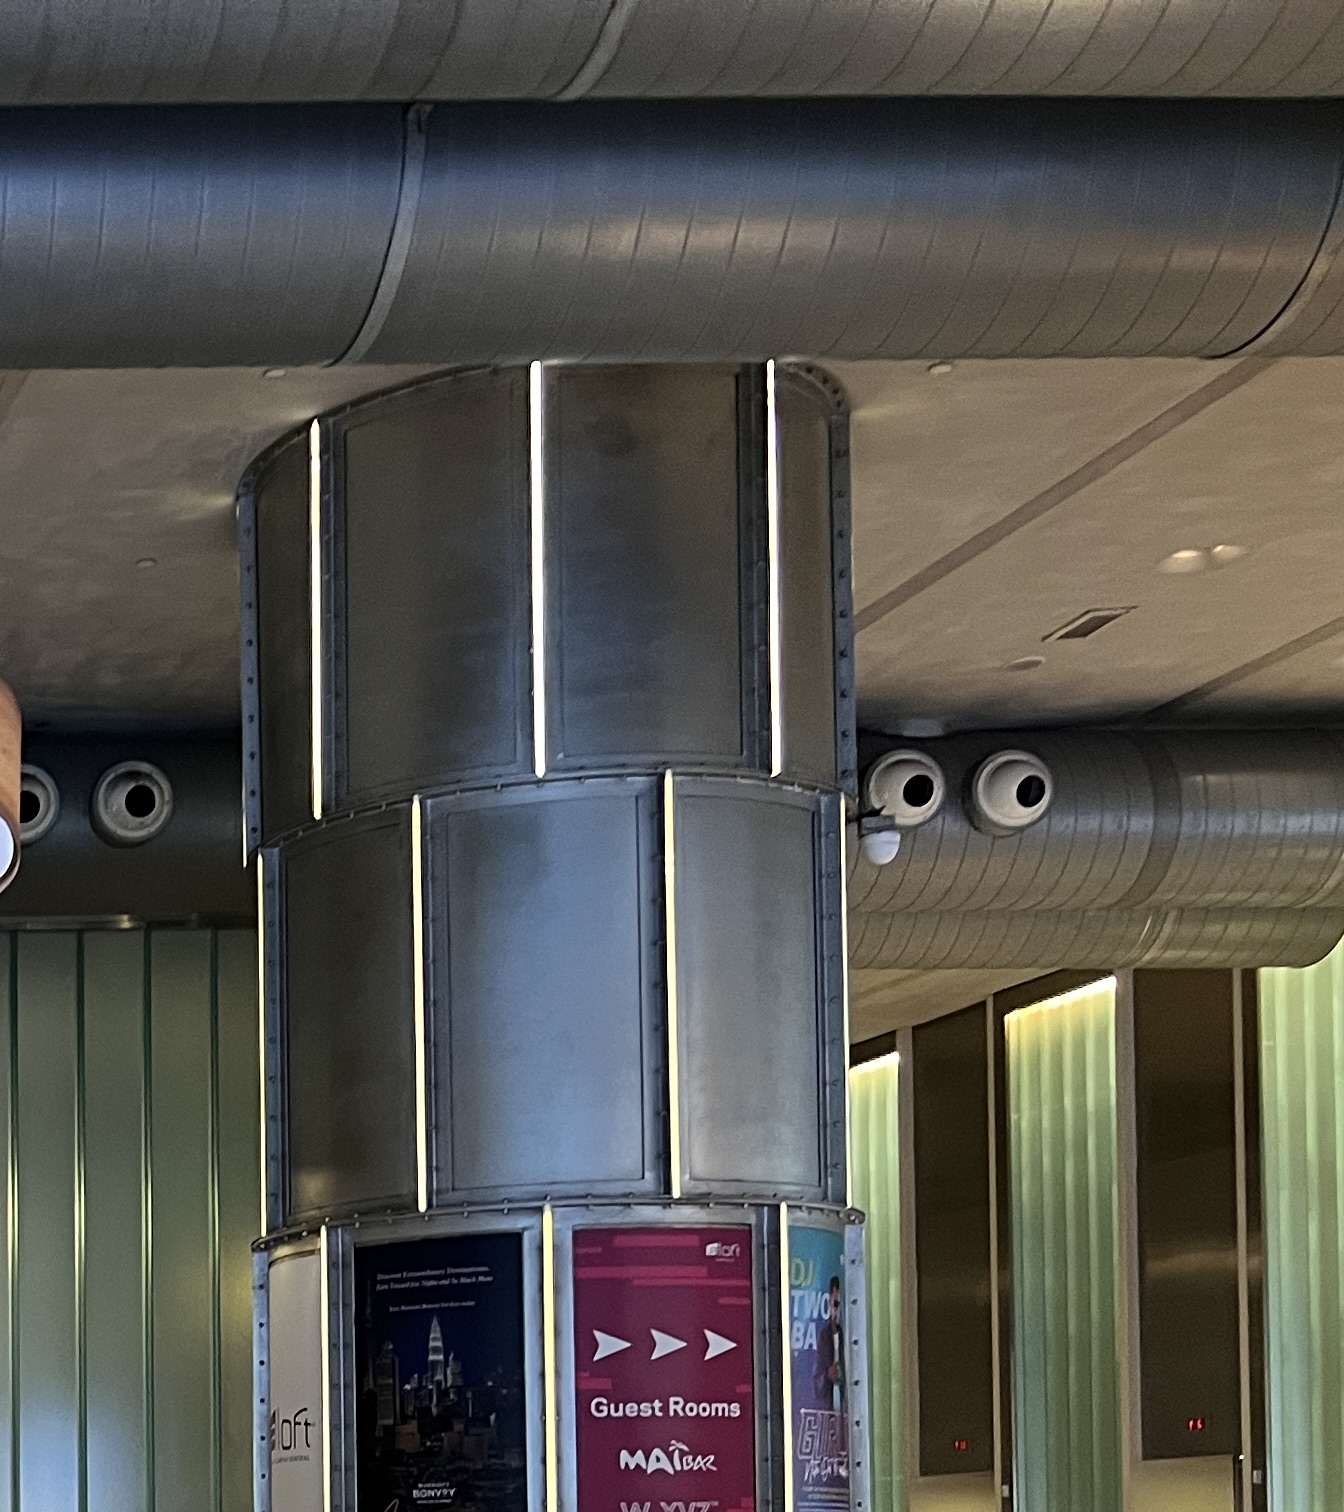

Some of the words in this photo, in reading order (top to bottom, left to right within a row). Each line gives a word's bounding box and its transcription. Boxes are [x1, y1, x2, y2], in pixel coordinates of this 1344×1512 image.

[791, 1289, 831, 1320] TWO
[590, 1397, 663, 1418] Guest
[669, 1396, 741, 1418] Rooms
